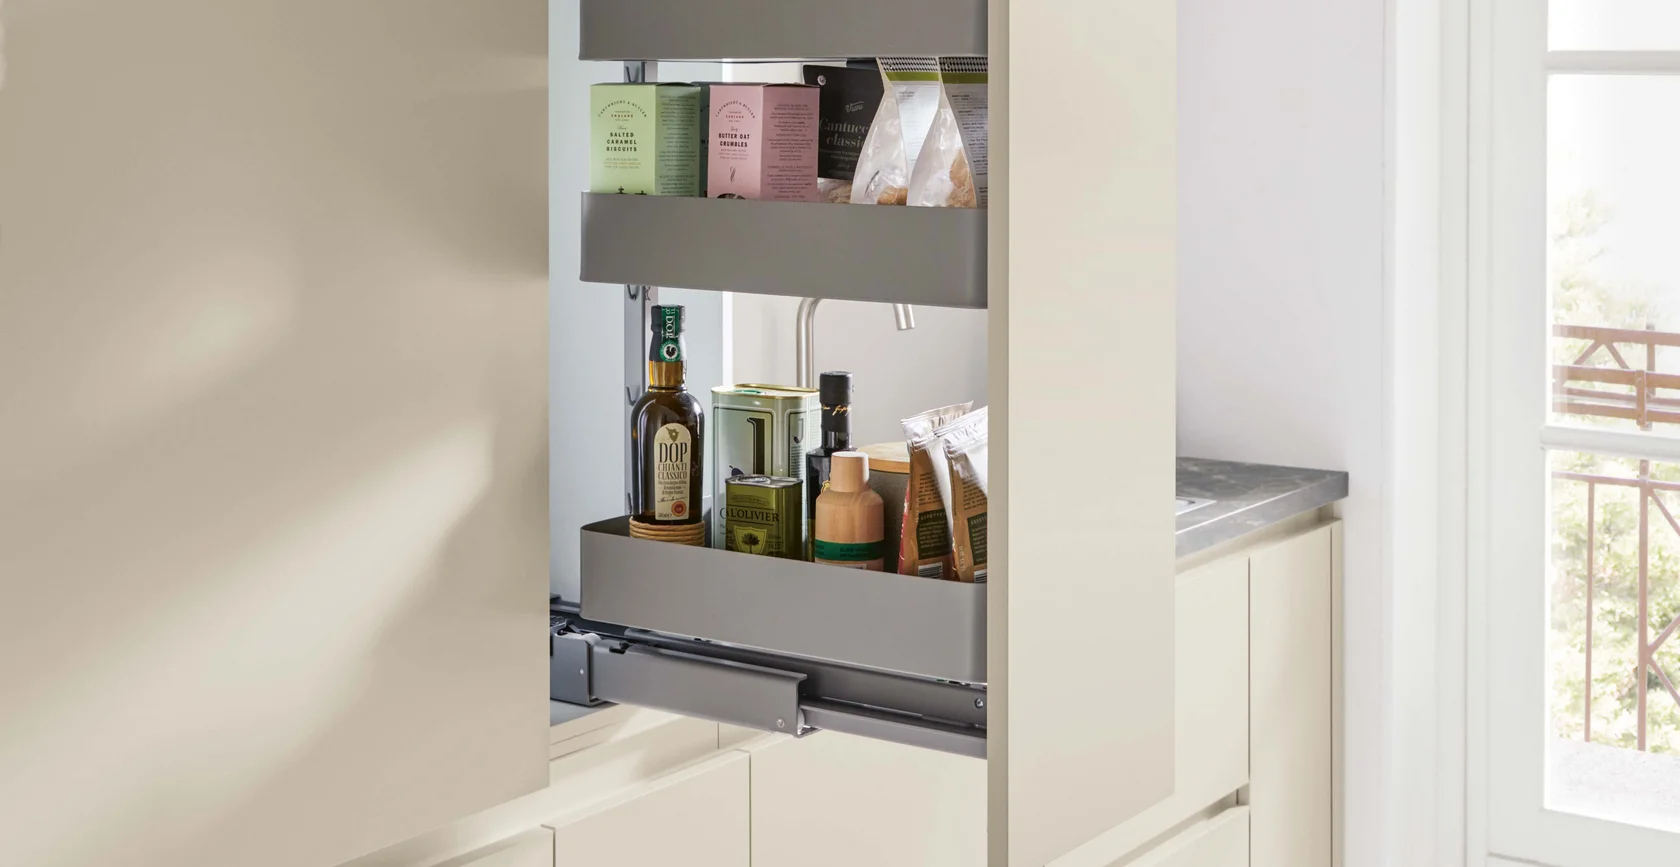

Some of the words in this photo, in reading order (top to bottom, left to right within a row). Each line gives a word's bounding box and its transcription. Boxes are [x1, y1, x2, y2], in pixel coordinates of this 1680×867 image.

[820, 116, 869, 134] Cantucc
[720, 140, 748, 148] CRUMBLES
[659, 442, 688, 463] DOP
[658, 463, 687, 471] CHIANTI
[658, 471, 687, 479] CLASSICO
[730, 508, 780, 522] L'OLIVIER
